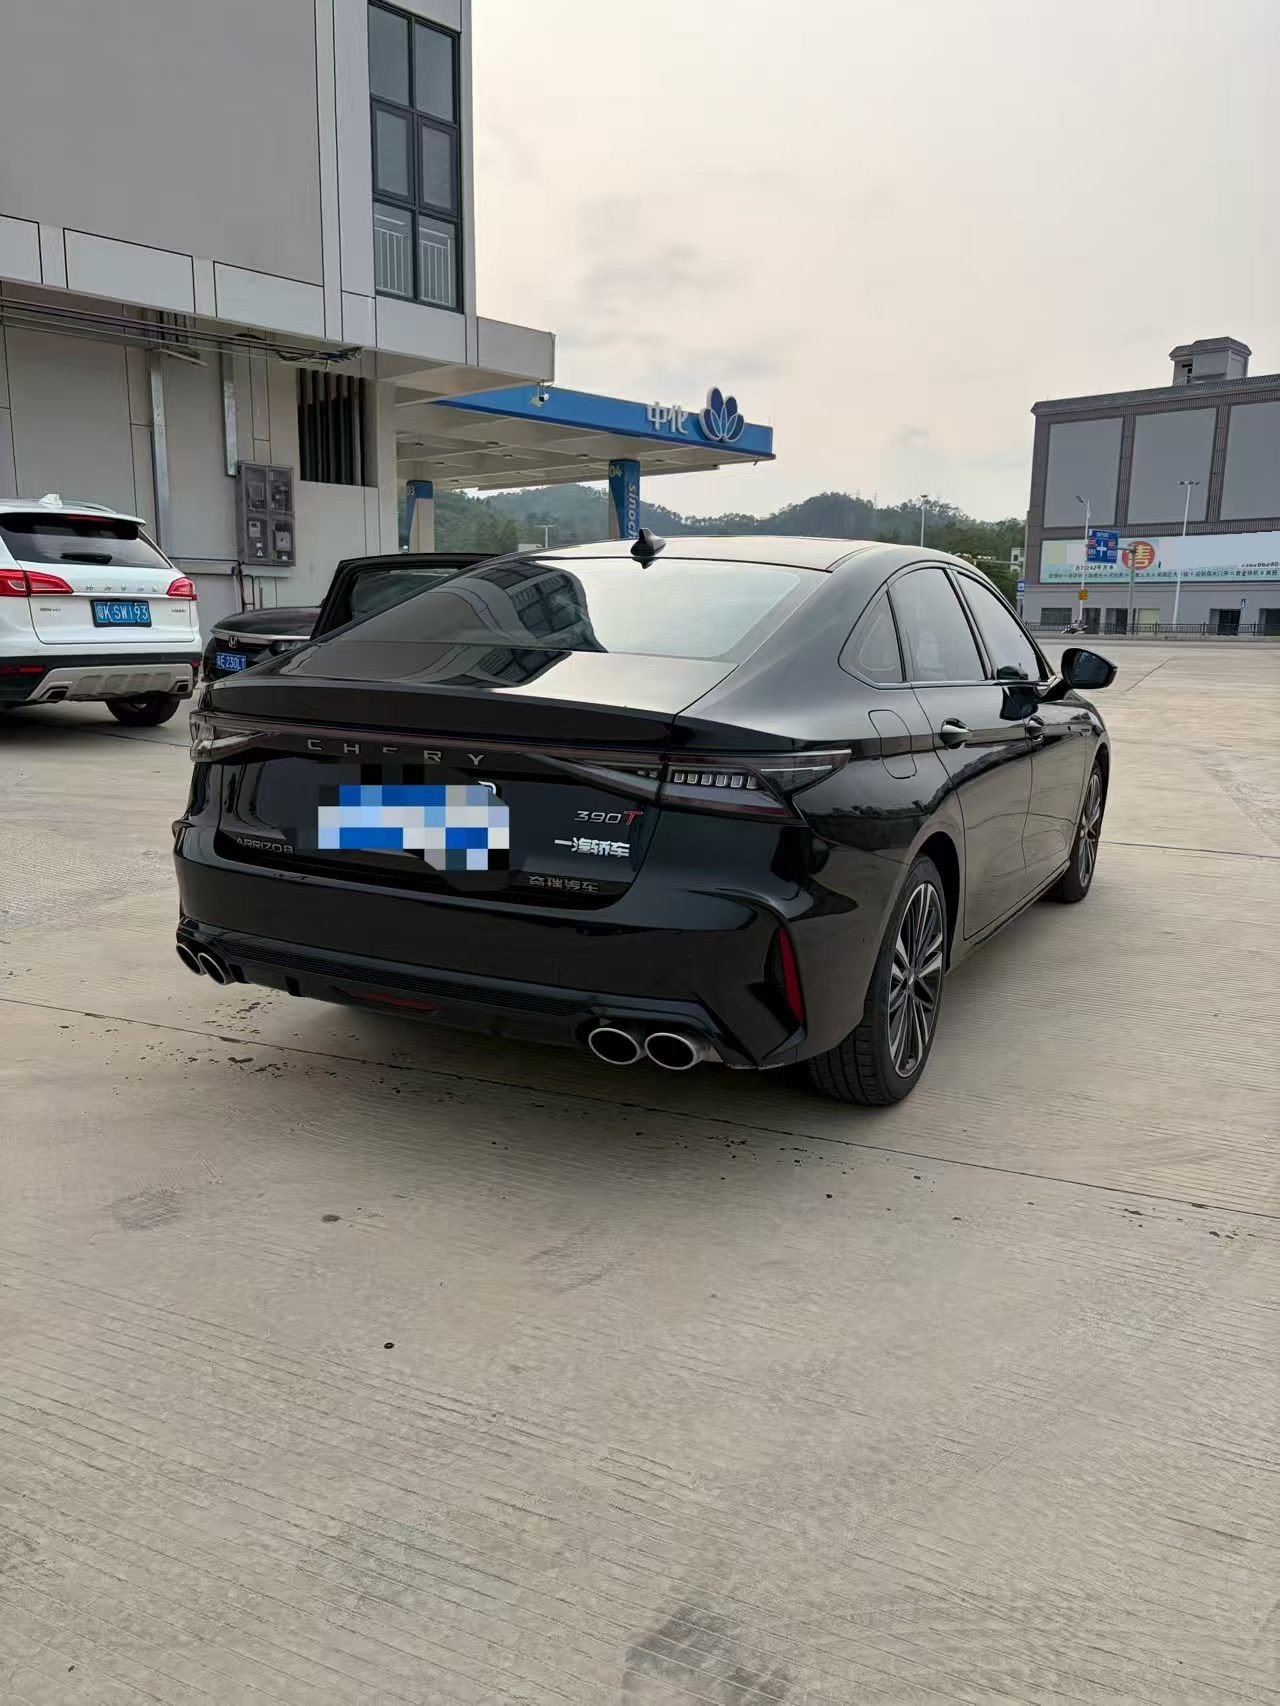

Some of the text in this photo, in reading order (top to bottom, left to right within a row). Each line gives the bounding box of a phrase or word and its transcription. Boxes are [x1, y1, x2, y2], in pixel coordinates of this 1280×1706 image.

[646, 402, 689, 434] 中化
[574, 810, 643, 825] 390T
[529, 875, 600, 893] 奇瑞汽车
